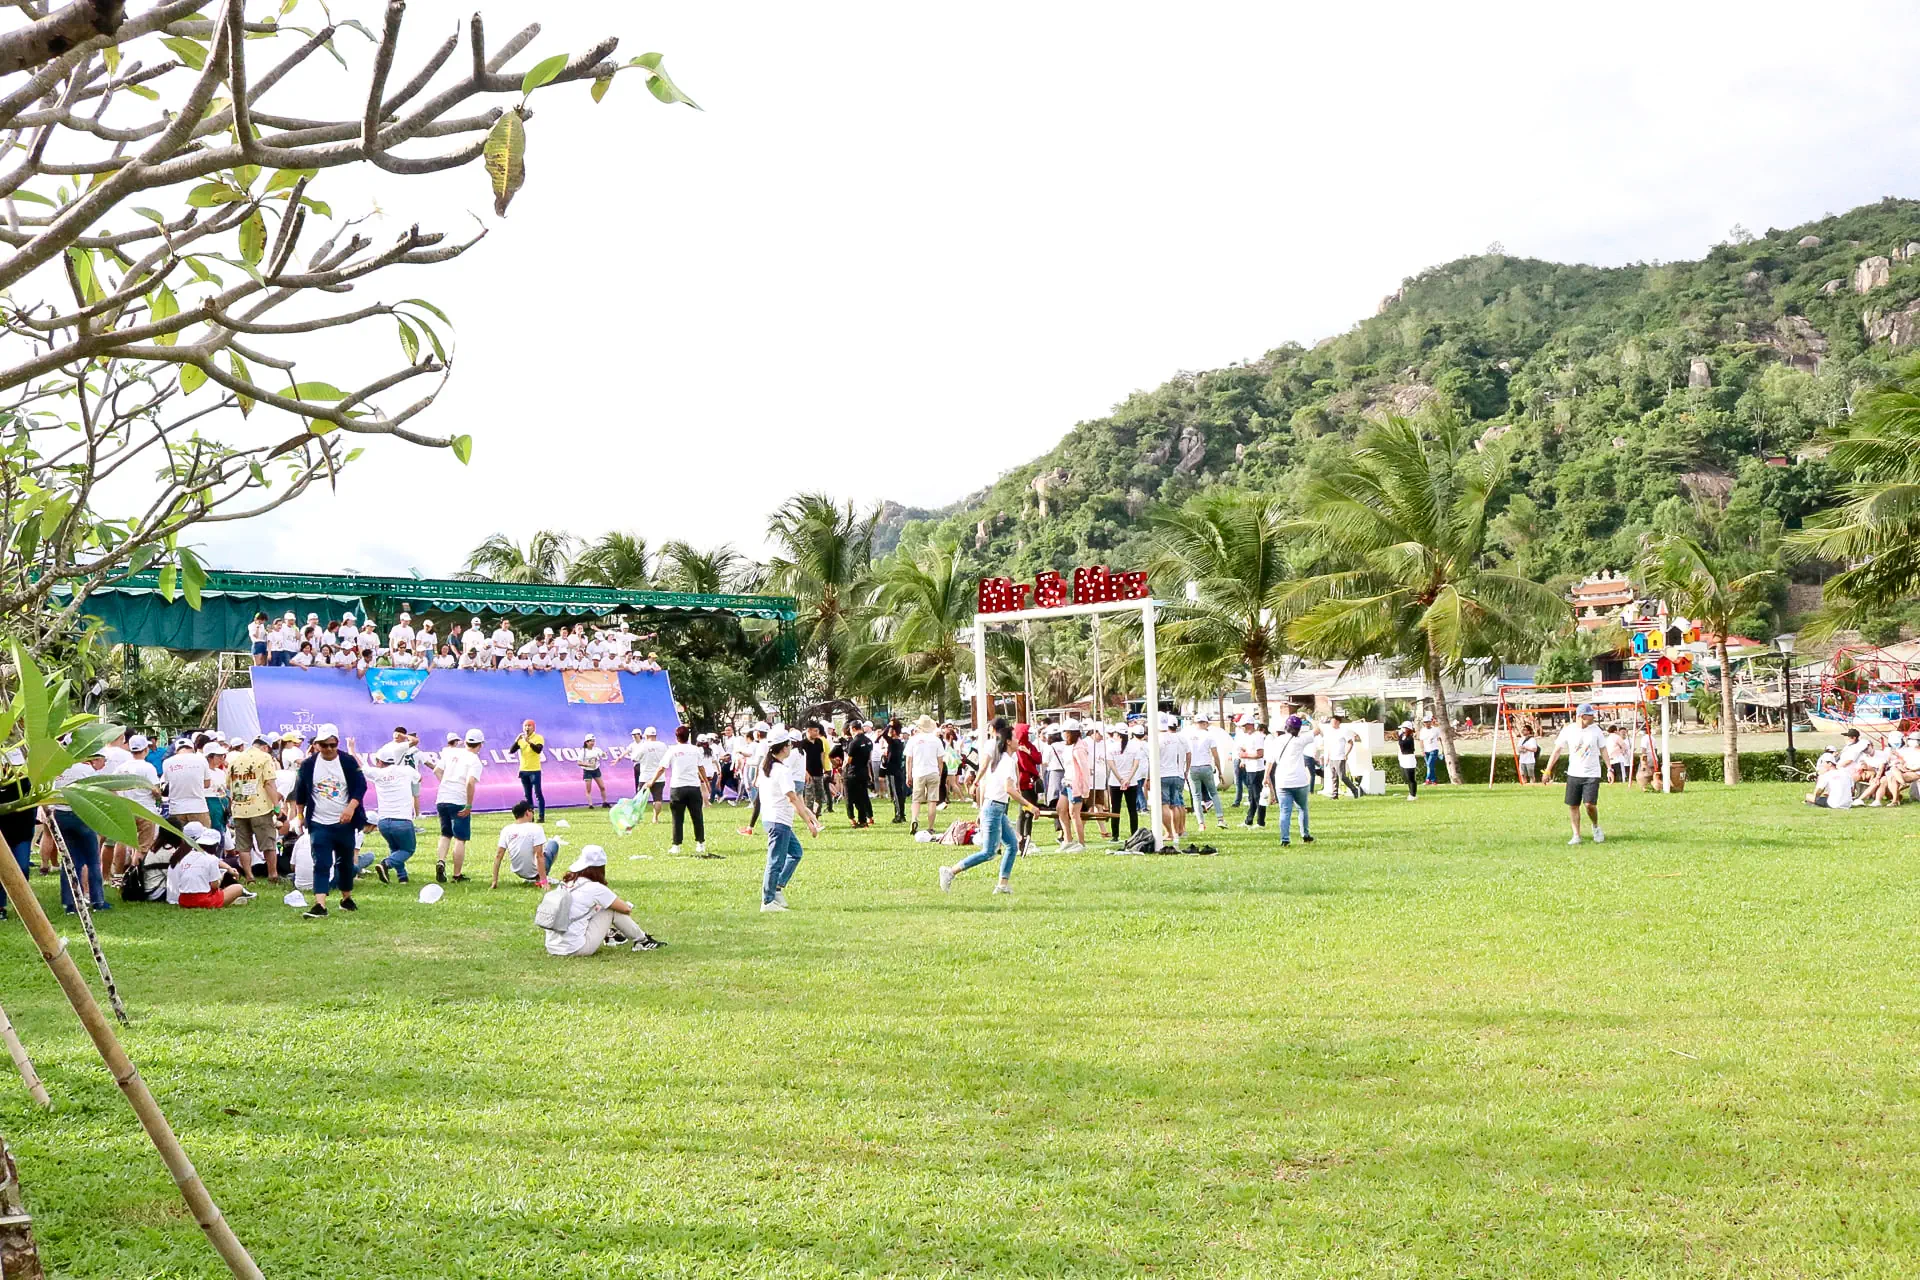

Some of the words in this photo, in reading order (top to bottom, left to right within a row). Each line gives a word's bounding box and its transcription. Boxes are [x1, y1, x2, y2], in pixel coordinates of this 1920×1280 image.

[978, 577, 1030, 613] Mr
[1034, 571, 1068, 607] &
[1074, 565, 1149, 604] Mrs
